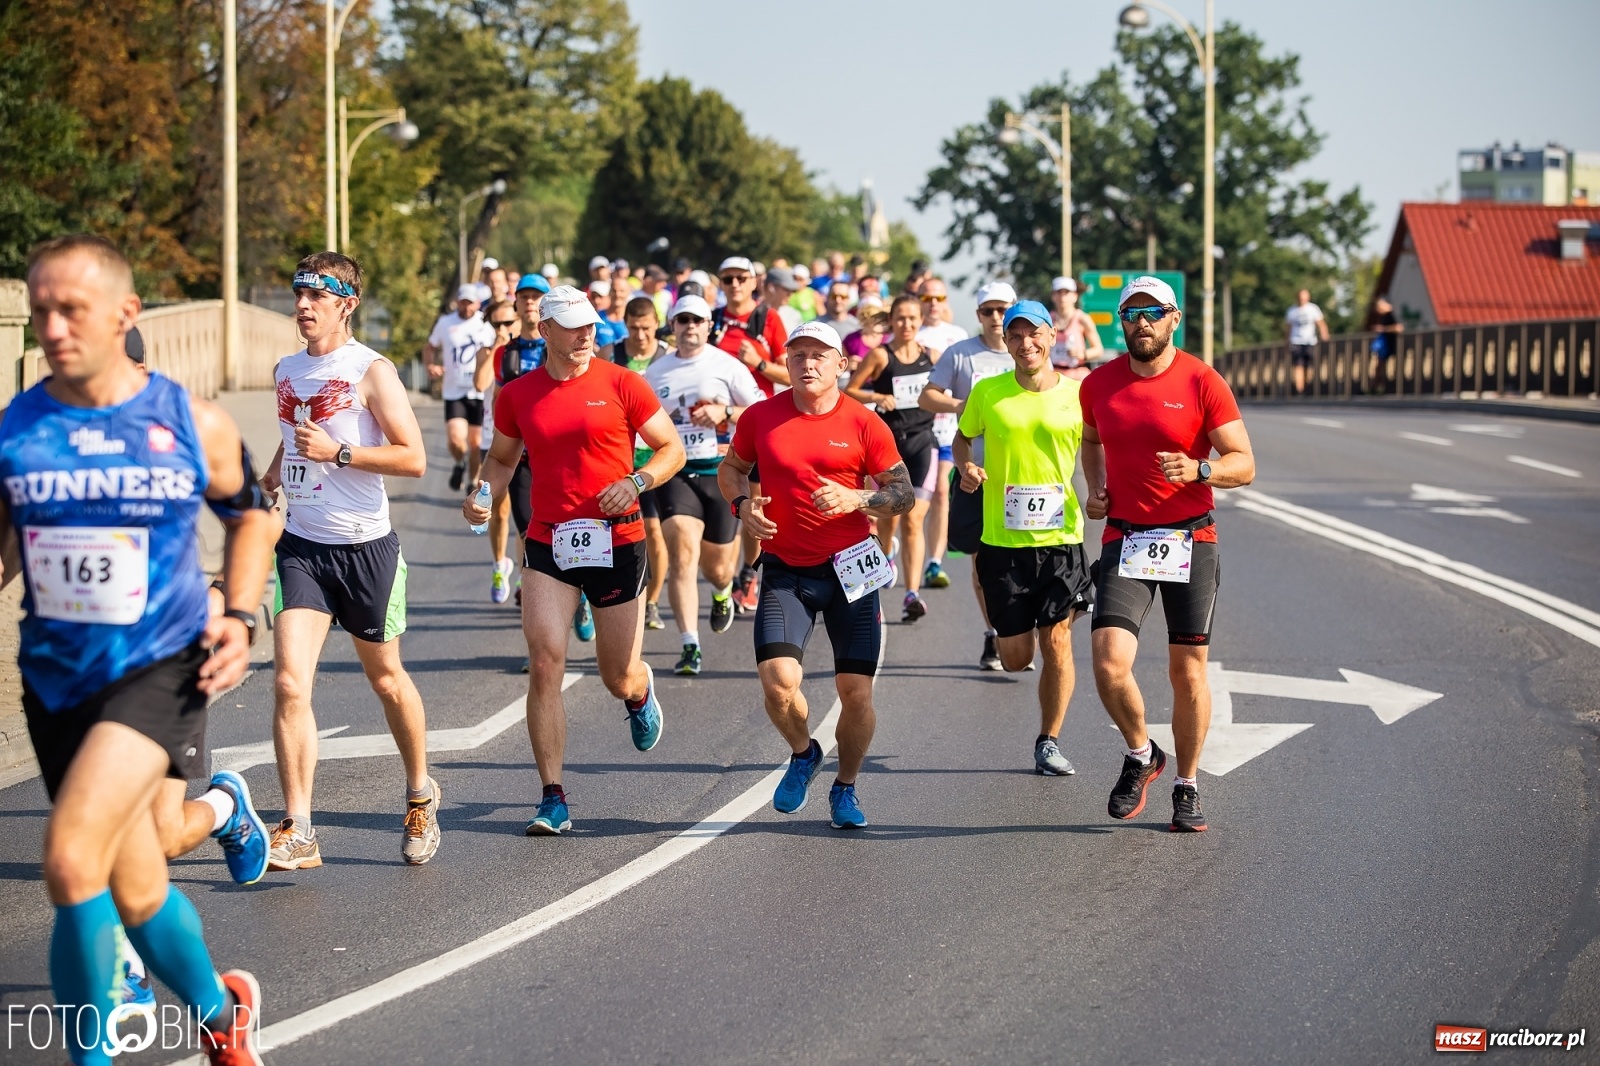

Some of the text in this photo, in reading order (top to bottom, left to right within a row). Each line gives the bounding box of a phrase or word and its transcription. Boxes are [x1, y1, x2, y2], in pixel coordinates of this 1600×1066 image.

[683, 432, 705, 446] 195
[287, 464, 307, 483] 177
[4, 466, 197, 506] RUNNERS
[1027, 497, 1046, 512] 67
[571, 531, 592, 548] 68
[1147, 542, 1170, 560] 89
[62, 555, 113, 584] 163
[856, 550, 881, 575] 146
